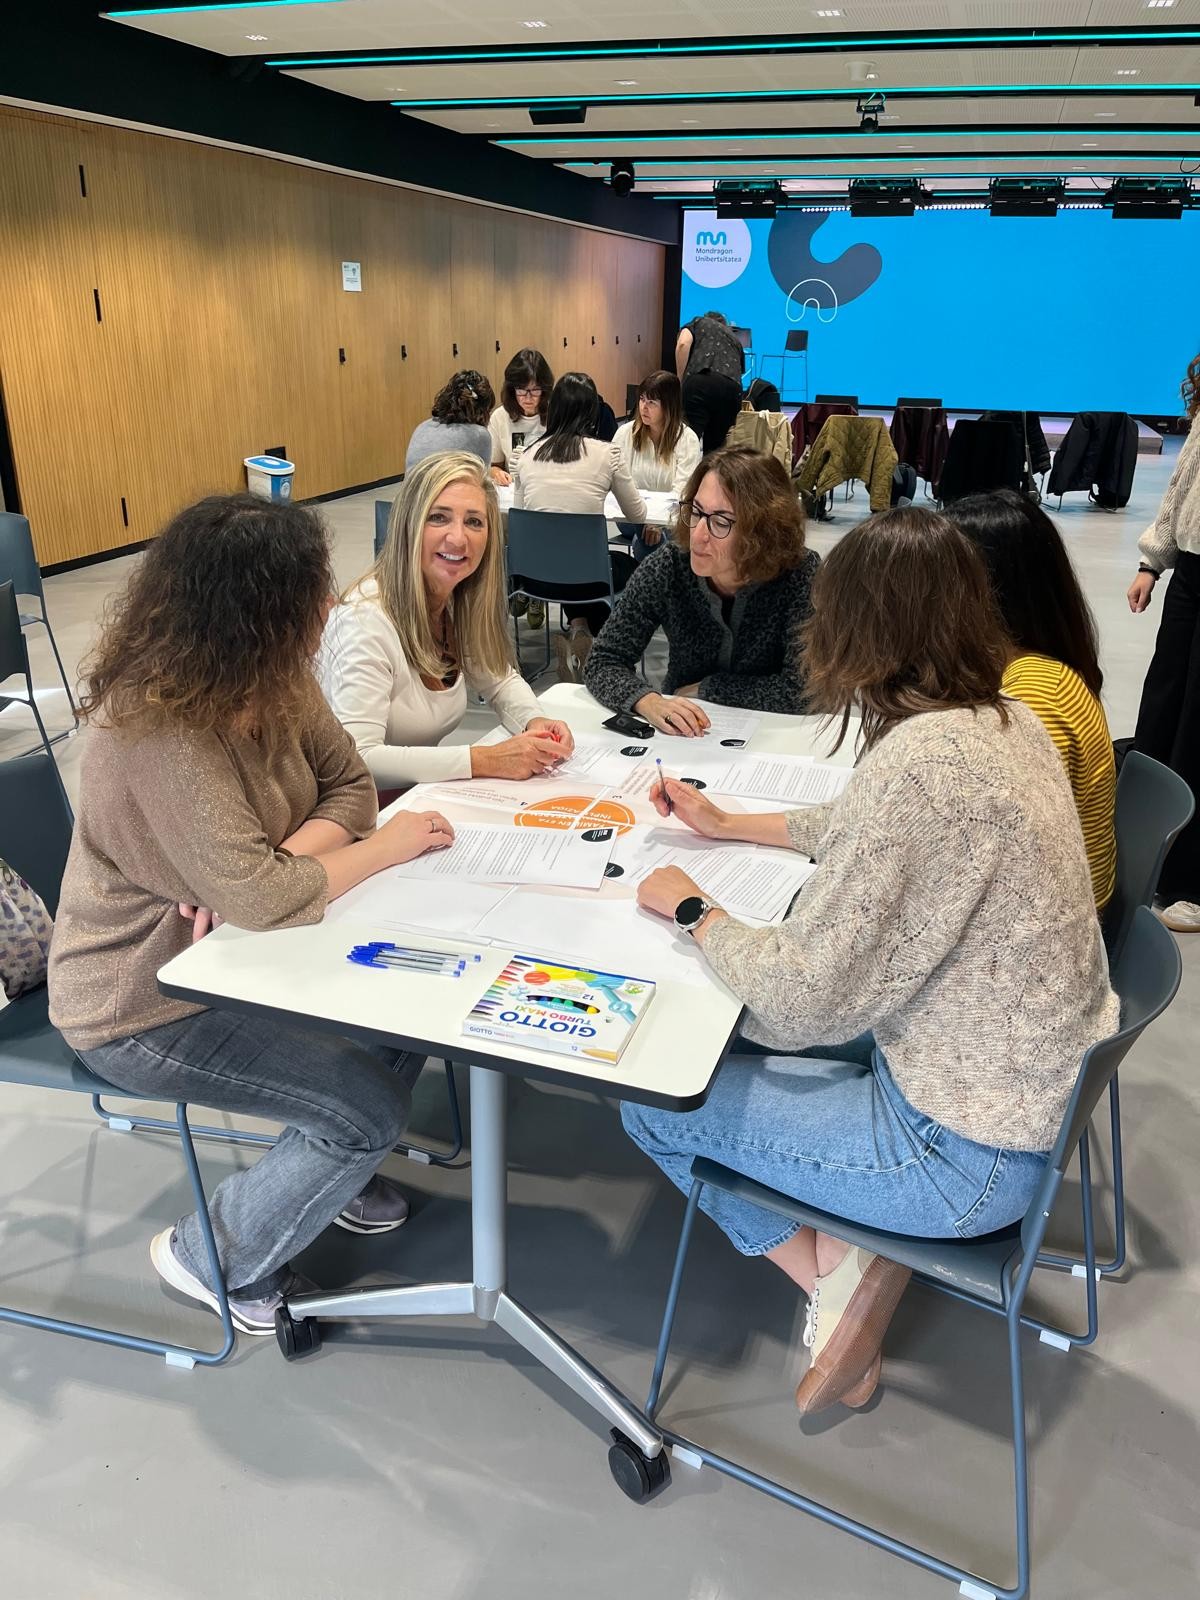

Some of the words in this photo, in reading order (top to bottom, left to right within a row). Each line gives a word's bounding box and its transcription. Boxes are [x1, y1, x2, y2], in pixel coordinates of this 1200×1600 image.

[582, 993, 595, 1001] 12
[513, 1005, 547, 1017] MAXI
[499, 1011, 597, 1038] GIOTTO
[549, 1012, 593, 1026] TURBO
[469, 1026, 493, 1036] GIOTTO
